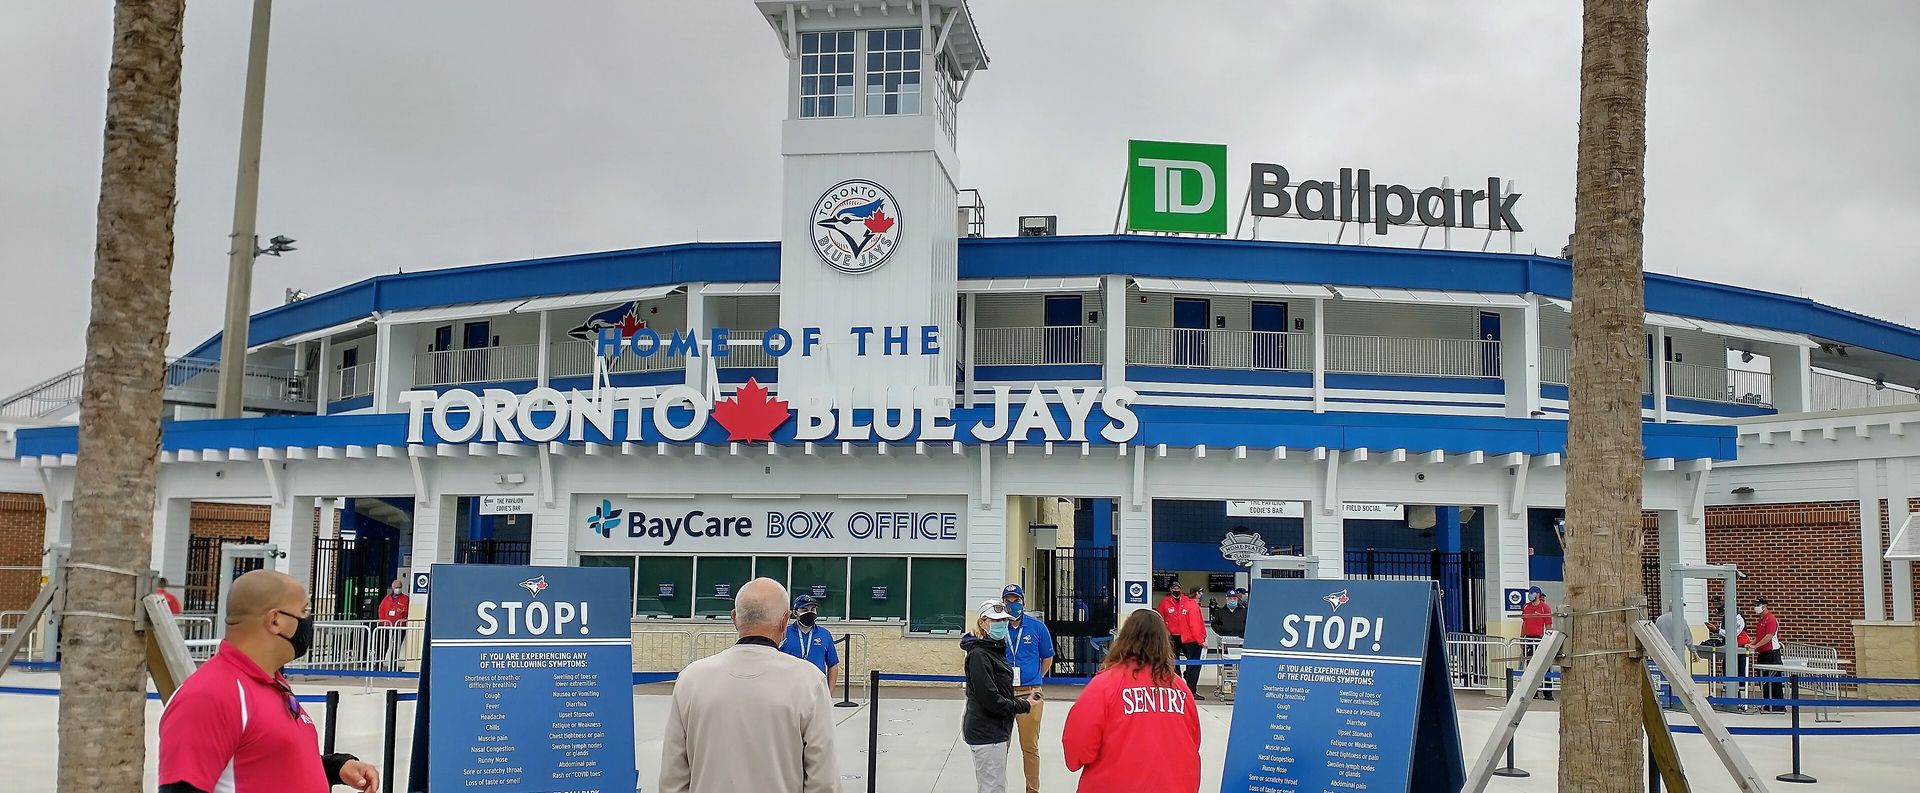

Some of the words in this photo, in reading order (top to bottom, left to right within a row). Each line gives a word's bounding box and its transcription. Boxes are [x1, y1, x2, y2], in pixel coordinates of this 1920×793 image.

[819, 186, 876, 216] TORONTO
[1138, 158, 1216, 214] TD
[1251, 162, 1523, 235] Ballpark
[818, 236, 852, 266] BLUE
[859, 237, 892, 266] JAYS
[597, 327, 730, 358] HOME
[764, 327, 821, 357] OF
[850, 326, 940, 356] THE
[398, 384, 708, 442] TORONTO
[794, 385, 956, 441] BLUE
[970, 382, 1139, 442] JAYS
[628, 511, 752, 546] BayCare
[766, 512, 834, 540] BOX
[848, 512, 958, 540] OFFICE
[476, 601, 590, 636] STOP!
[1280, 614, 1384, 652] STOP!
[548, 660, 588, 668] SYMPTOMS:
[1314, 666, 1360, 676] EXPERIENCING
[1300, 674, 1335, 683] FOLLOWING
[1337, 677, 1374, 685] SYMPTOMS:
[1122, 687, 1186, 714] SENTRY
[1271, 755, 1294, 763] Congestion
